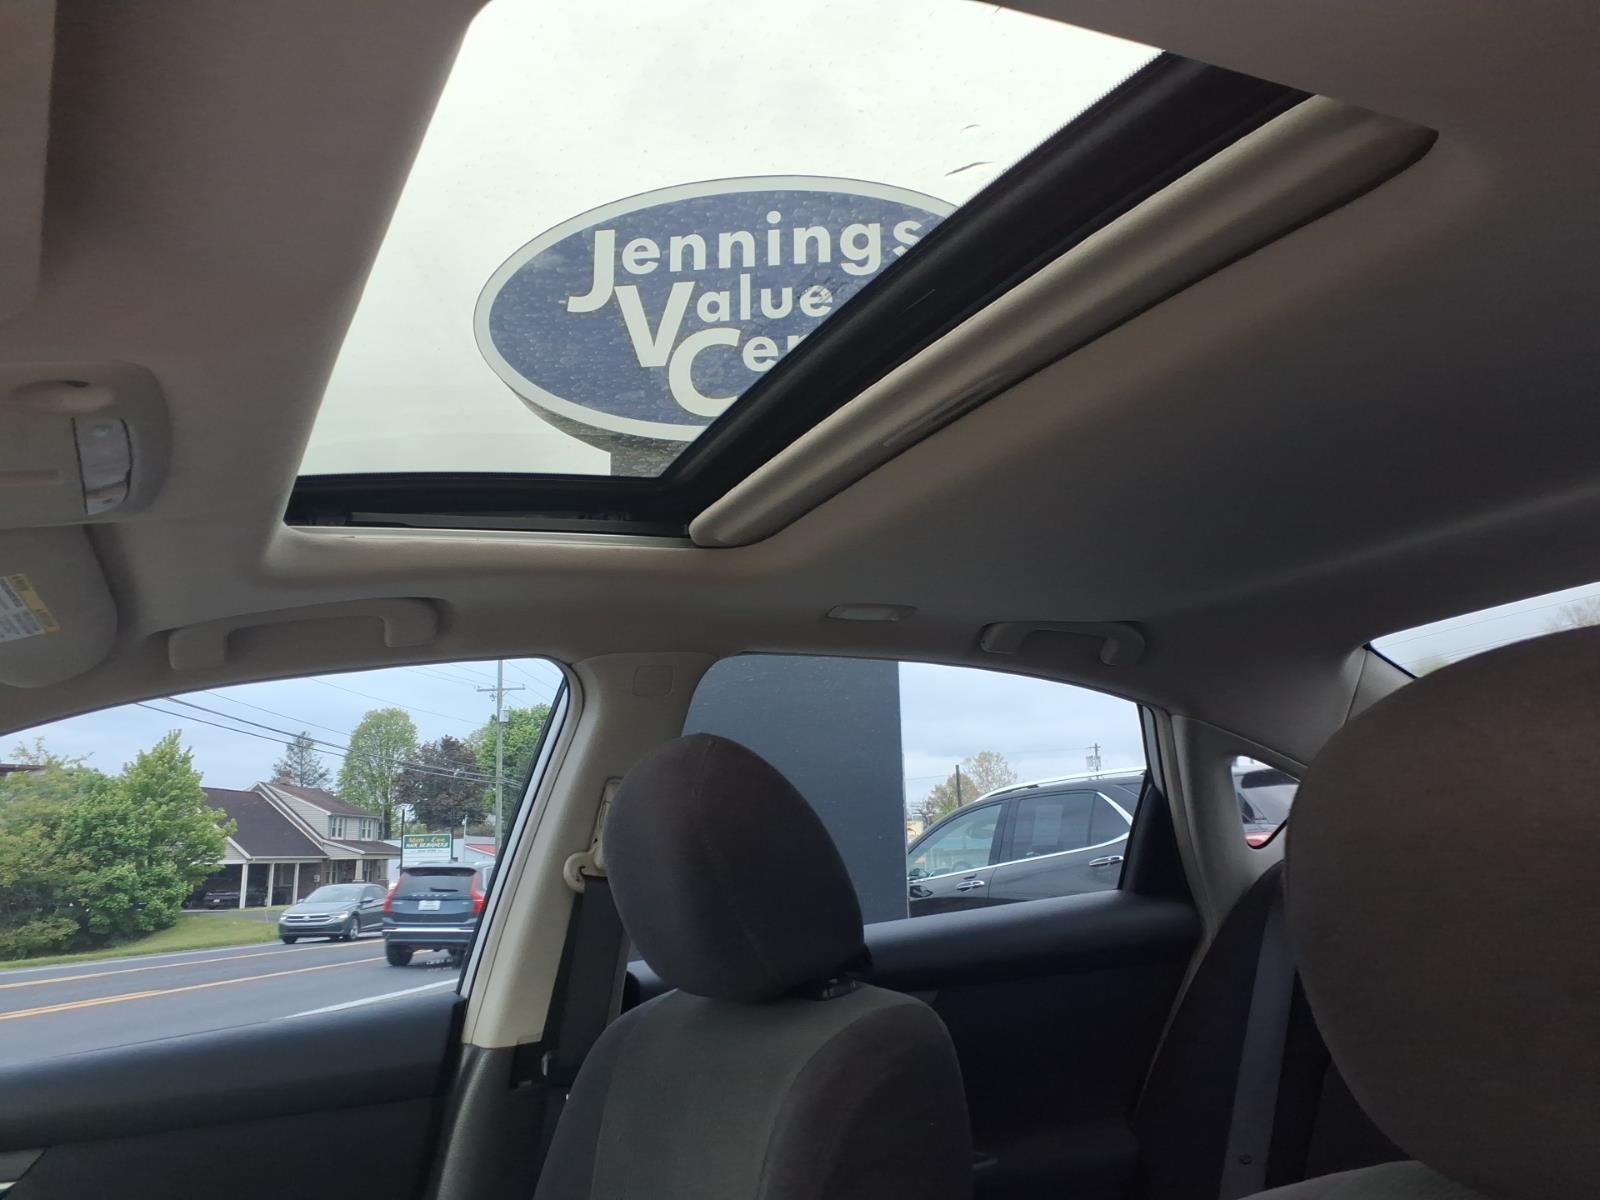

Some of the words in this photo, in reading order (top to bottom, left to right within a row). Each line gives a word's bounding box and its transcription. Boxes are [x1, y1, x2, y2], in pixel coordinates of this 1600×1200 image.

[567, 211, 922, 312] Jennings
[614, 273, 833, 367] Value
[668, 327, 811, 417] Ce
